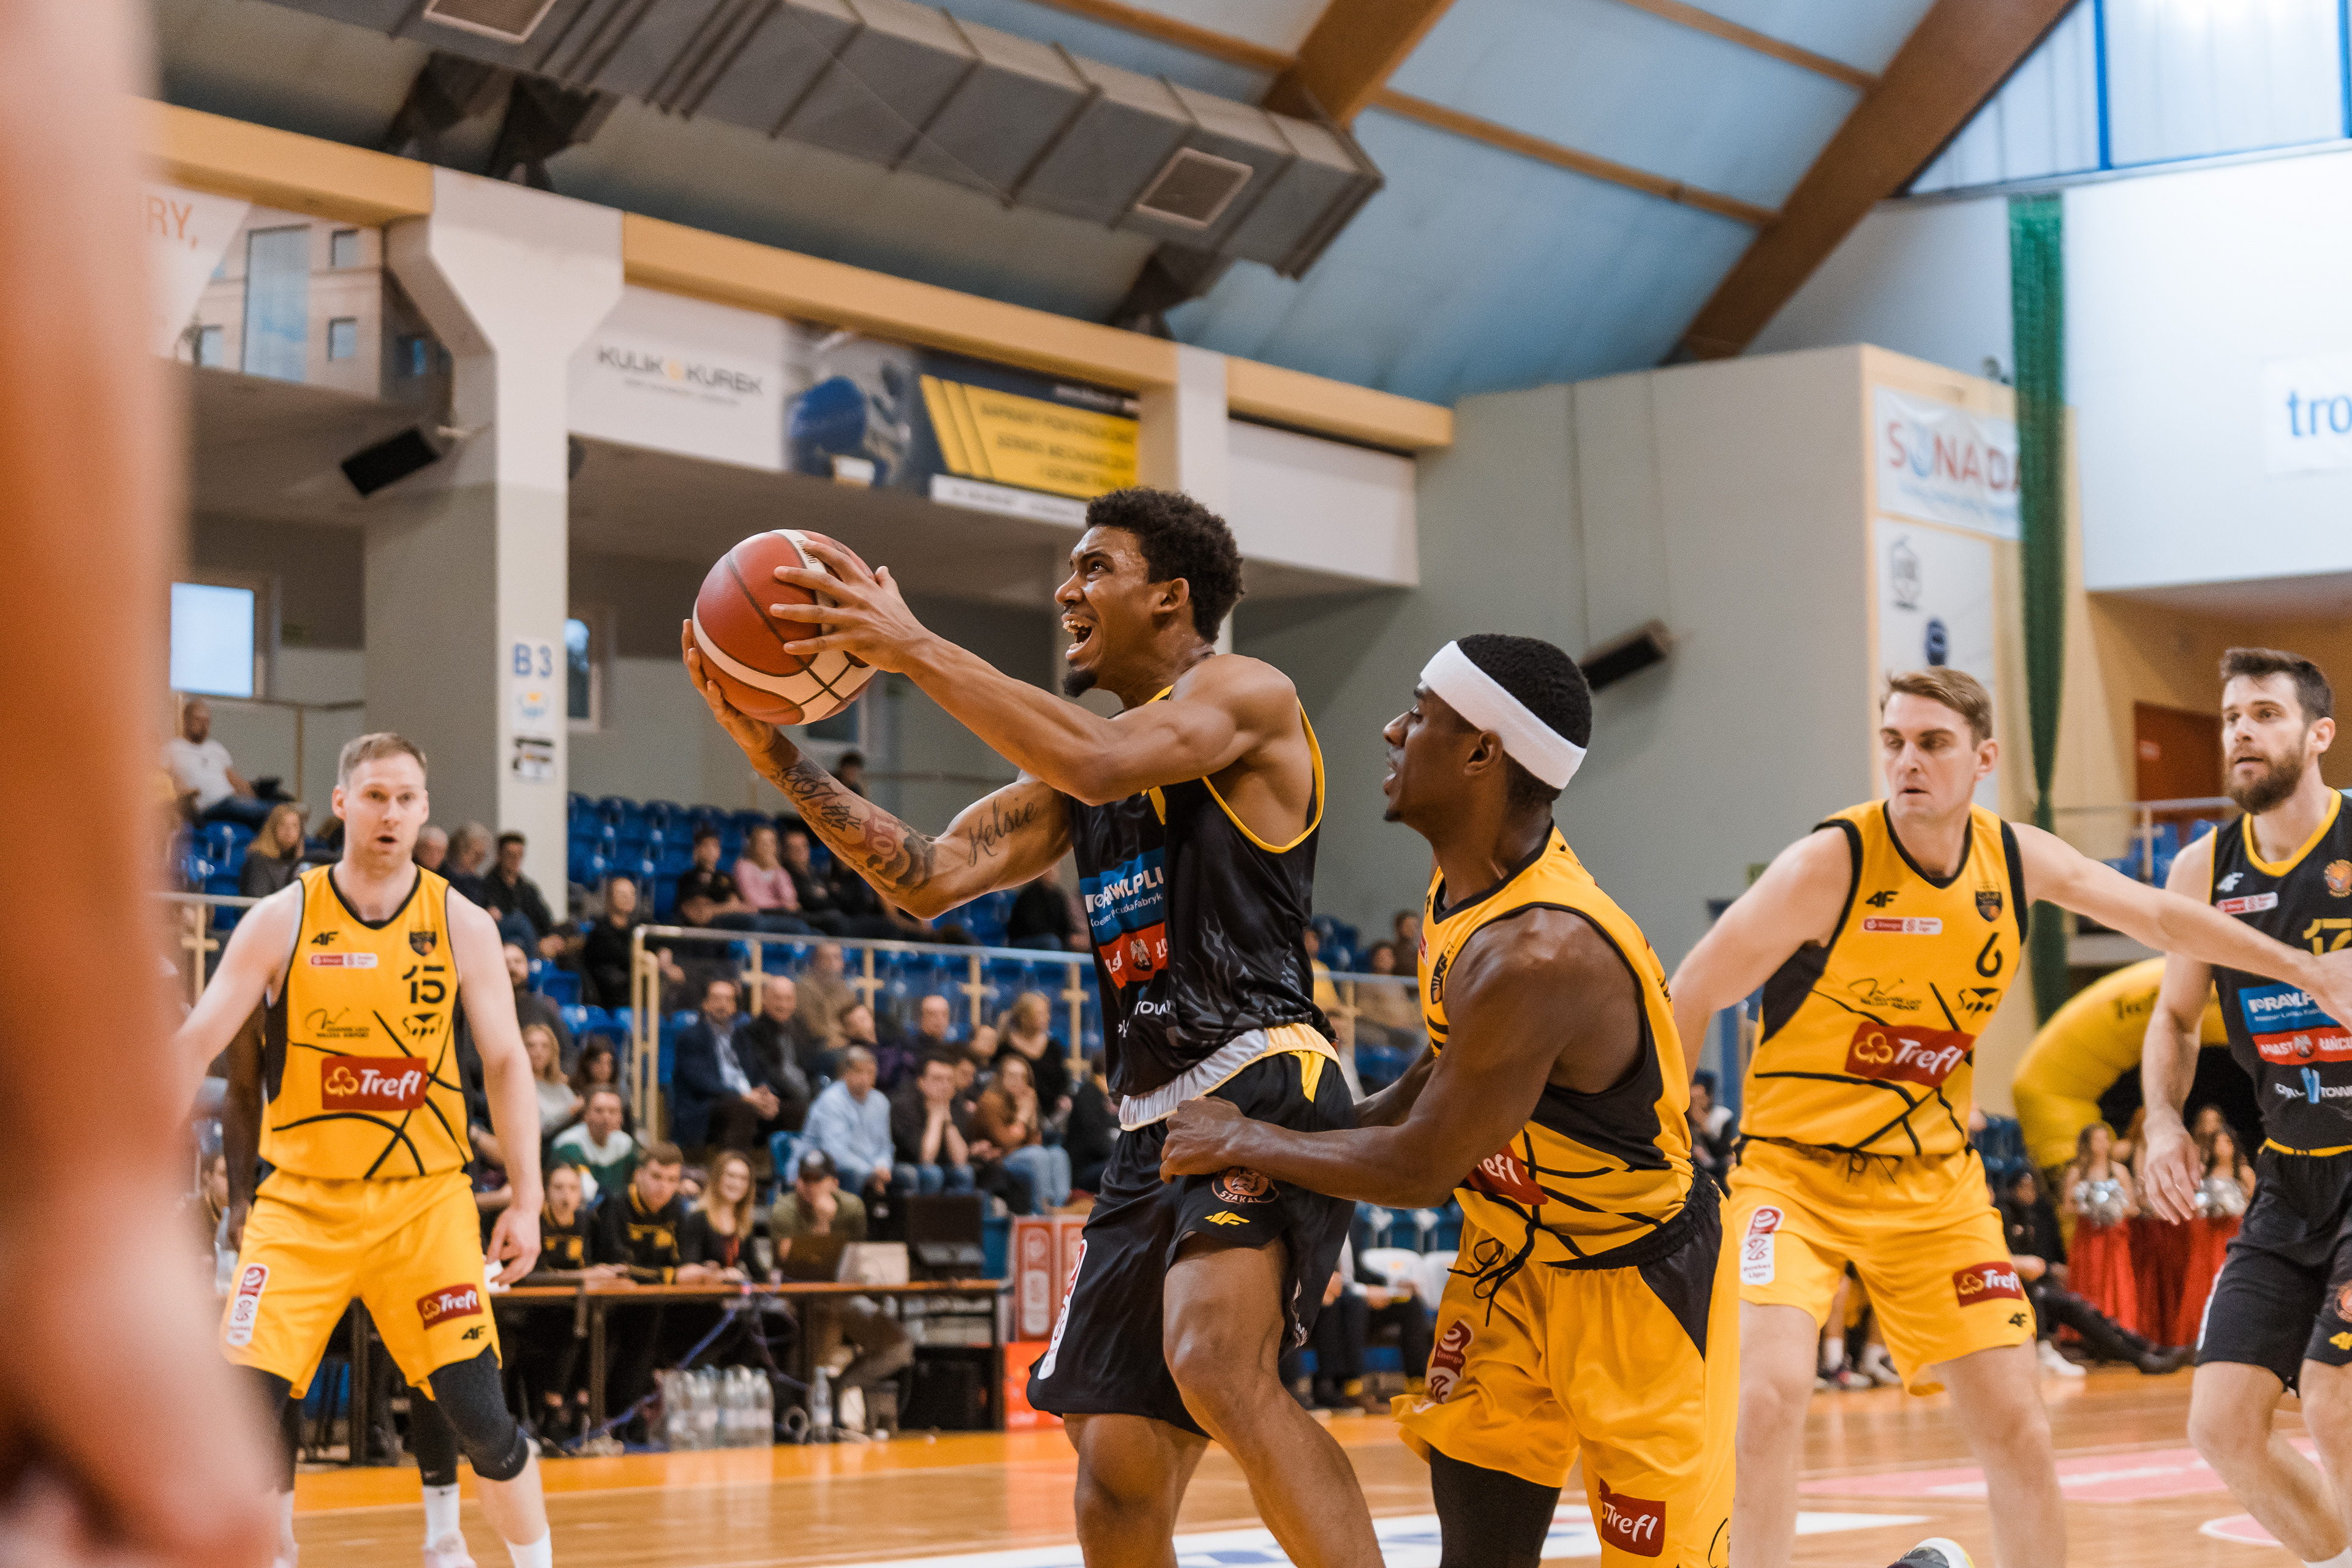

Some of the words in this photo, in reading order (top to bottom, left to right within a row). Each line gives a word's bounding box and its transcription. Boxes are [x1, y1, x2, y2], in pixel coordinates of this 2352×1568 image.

[2286, 390, 2352, 437] tro
[968, 797, 1036, 868] Kelsie
[1134, 892, 1164, 910] Fabryk
[1866, 890, 1898, 907] 4F
[311, 931, 339, 946] 4F
[1976, 932, 2003, 978] 6
[402, 965, 447, 1004] 15
[401, 1014, 443, 1044] Sopot
[1894, 1038, 1964, 1076] Trefl
[360, 1068, 423, 1101] Trefl
[1477, 1153, 1523, 1186] efl
[1982, 1268, 2021, 1292] Trefl
[439, 1289, 477, 1312] Trefl
[461, 1325, 486, 1340] 4F
[1603, 1501, 1659, 1542] Trefl
